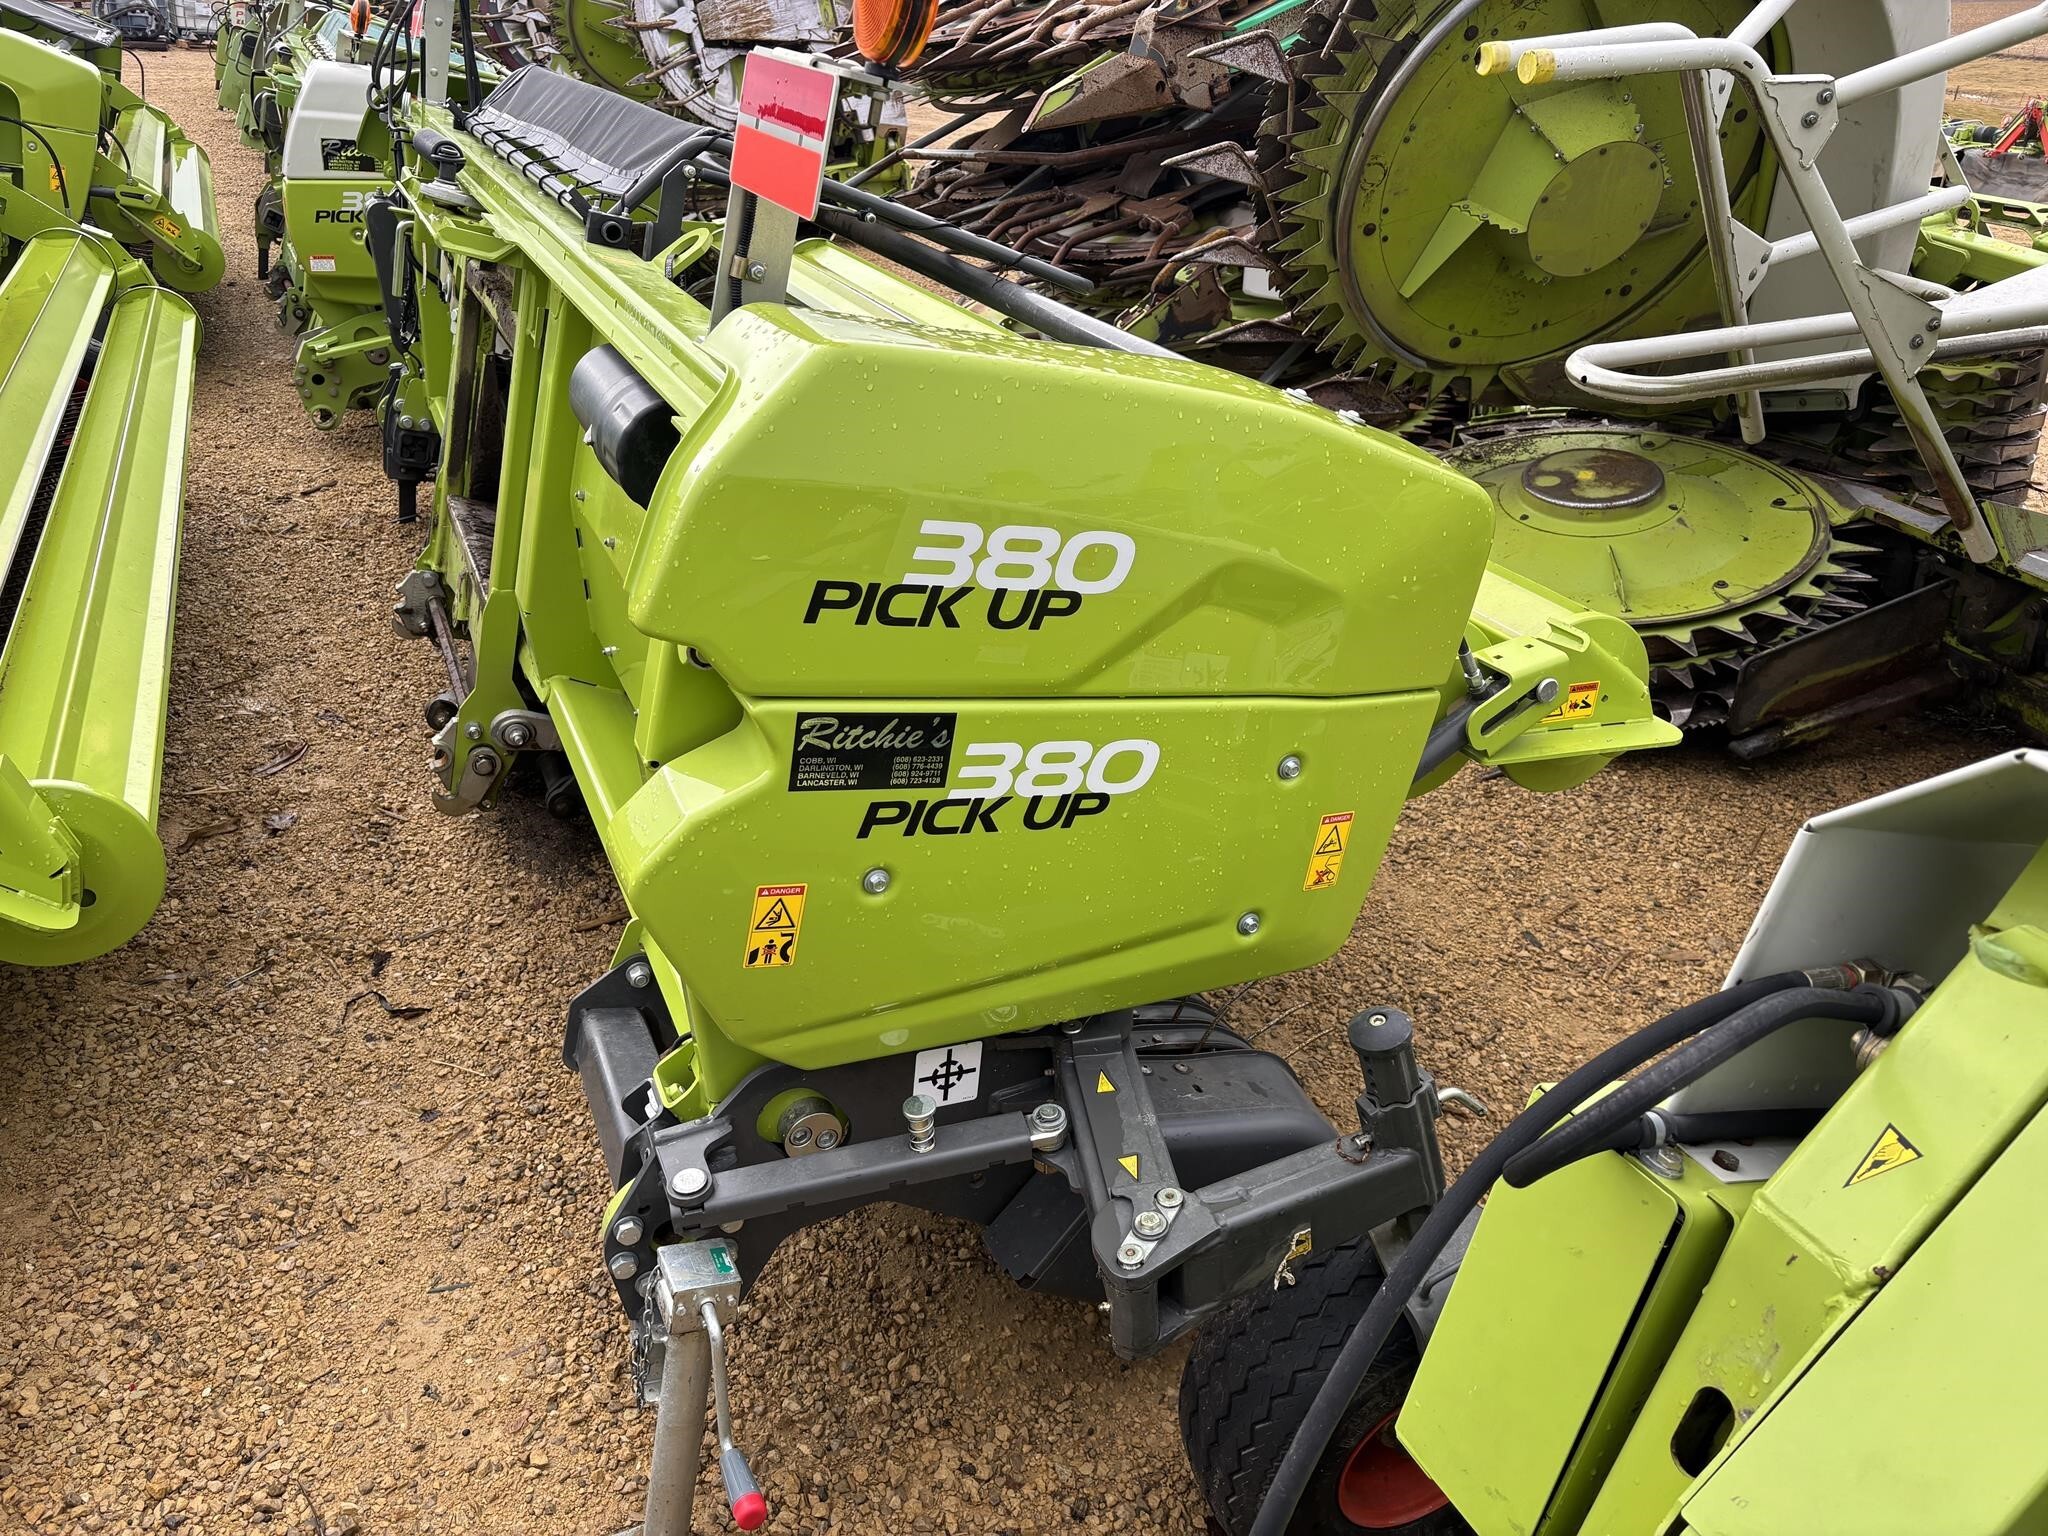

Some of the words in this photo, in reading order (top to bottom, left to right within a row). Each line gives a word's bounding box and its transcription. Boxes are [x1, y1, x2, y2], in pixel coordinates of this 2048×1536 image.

[315, 210, 364, 223] PICK
[902, 519, 1136, 595] 380
[803, 579, 976, 629] PICK
[986, 587, 1083, 631] UP
[797, 716, 951, 751] Ritchie's
[800, 757, 826, 765] COBB,
[913, 755, 944, 763] 623-2331
[799, 764, 853, 772] DARLINGTON,
[912, 762, 943, 770] 776-4439
[947, 739, 1161, 800] 380
[798, 772, 849, 780] BARNEVELD,
[796, 779, 847, 787] LANCASTER,
[890, 778, 909, 786] (608)
[856, 796, 1014, 839] PICK
[1022, 792, 1111, 830] UP
[770, 887, 801, 895] DANGER
